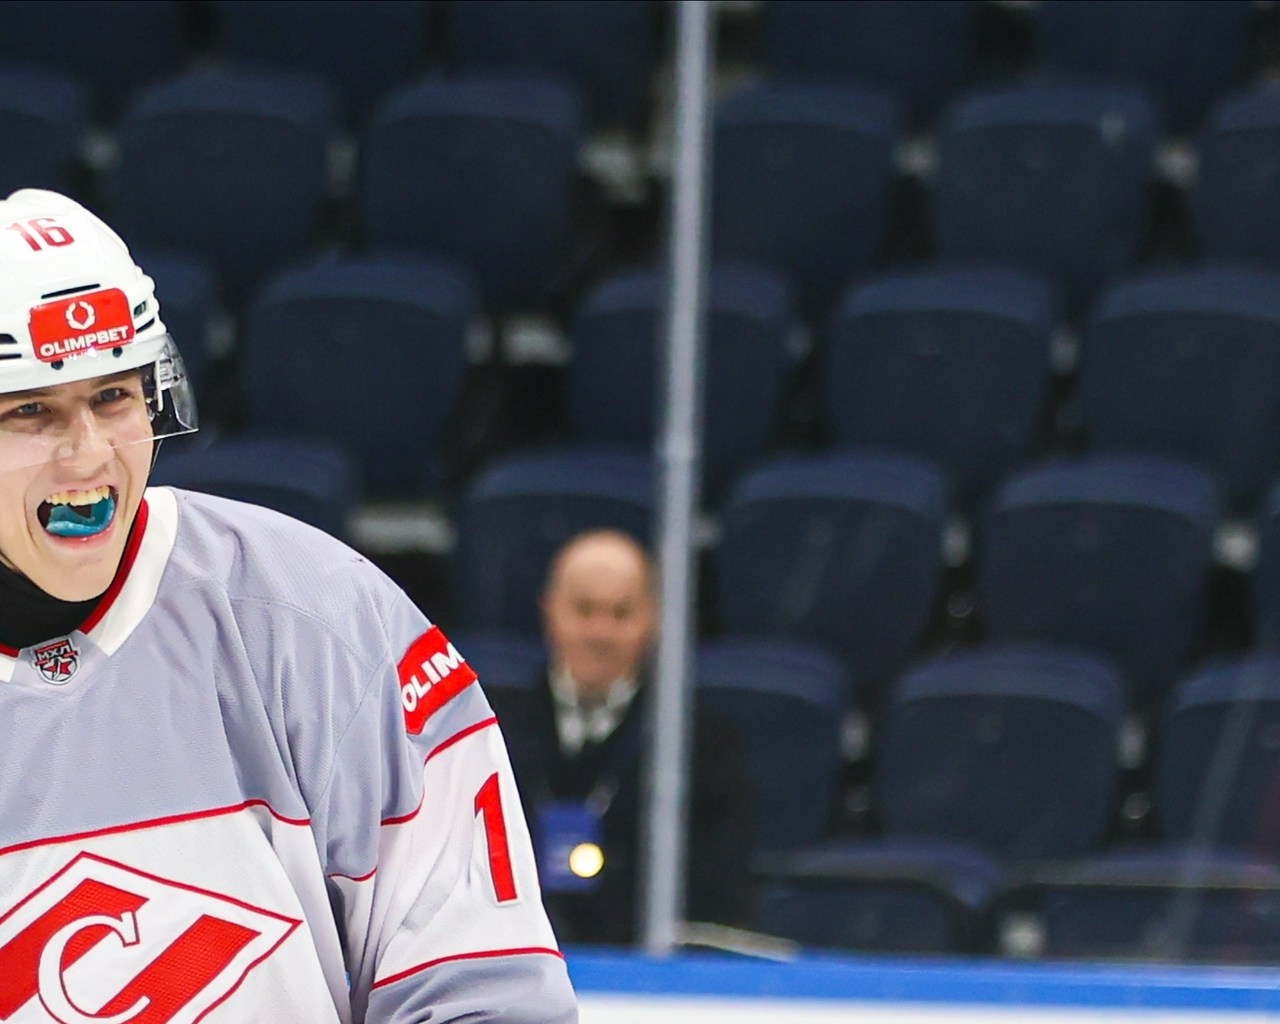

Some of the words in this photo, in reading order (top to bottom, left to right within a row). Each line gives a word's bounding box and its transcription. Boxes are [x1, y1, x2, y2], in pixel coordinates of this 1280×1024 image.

[7, 217, 75, 252] 16
[40, 325, 128, 358] OLIMPBET
[474, 771, 519, 903] 1
